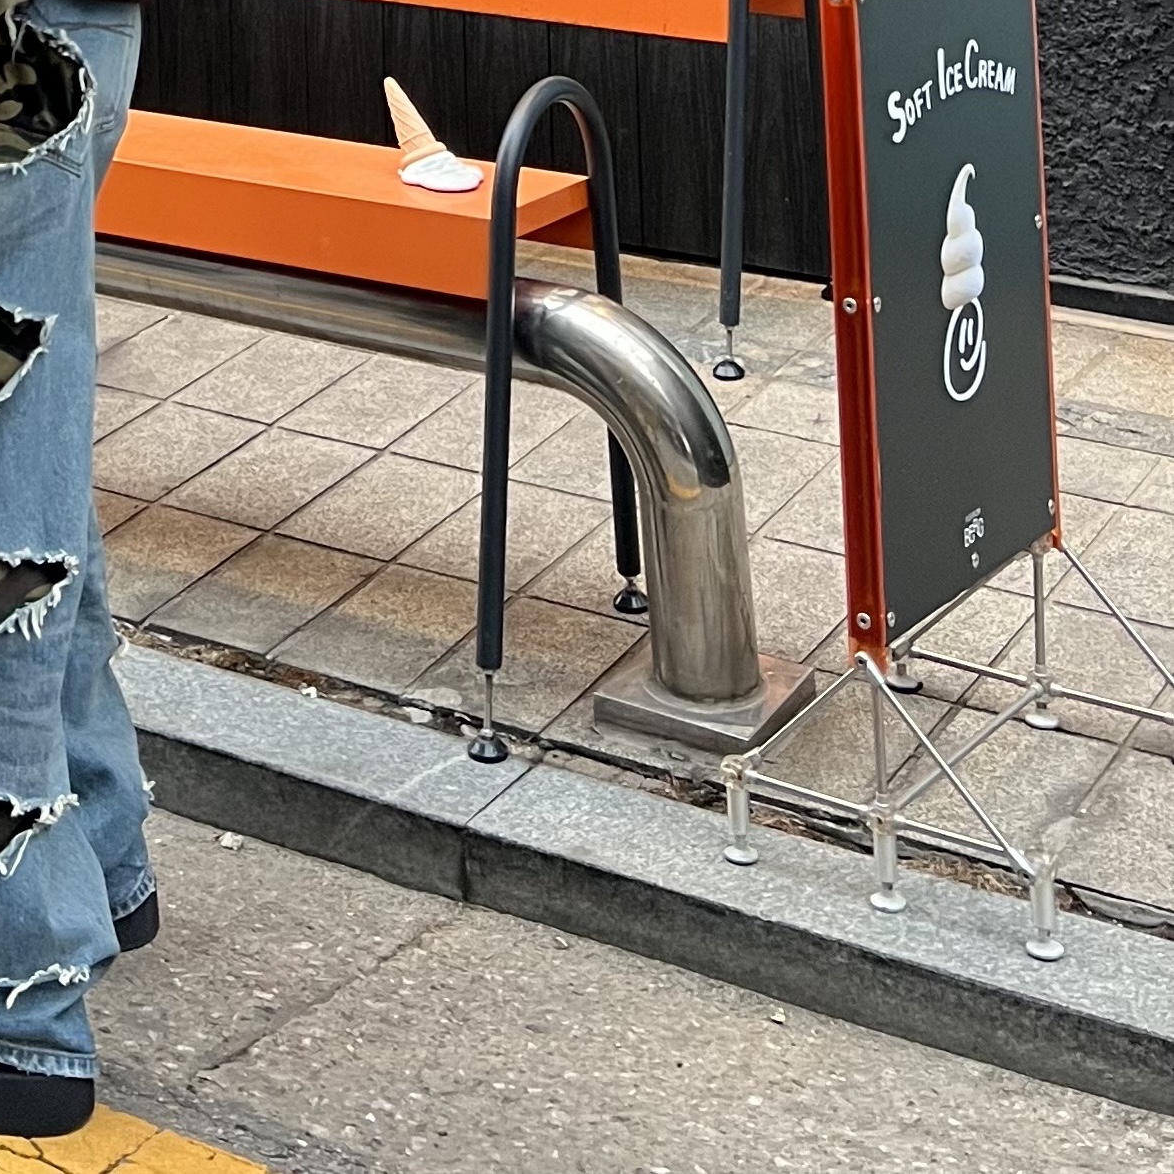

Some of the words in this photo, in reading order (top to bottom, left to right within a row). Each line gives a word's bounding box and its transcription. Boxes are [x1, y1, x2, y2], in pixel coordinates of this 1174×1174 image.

[887, 79, 933, 144] SOFT
[937, 47, 963, 100] ICE
[964, 38, 1016, 95] CREAM
